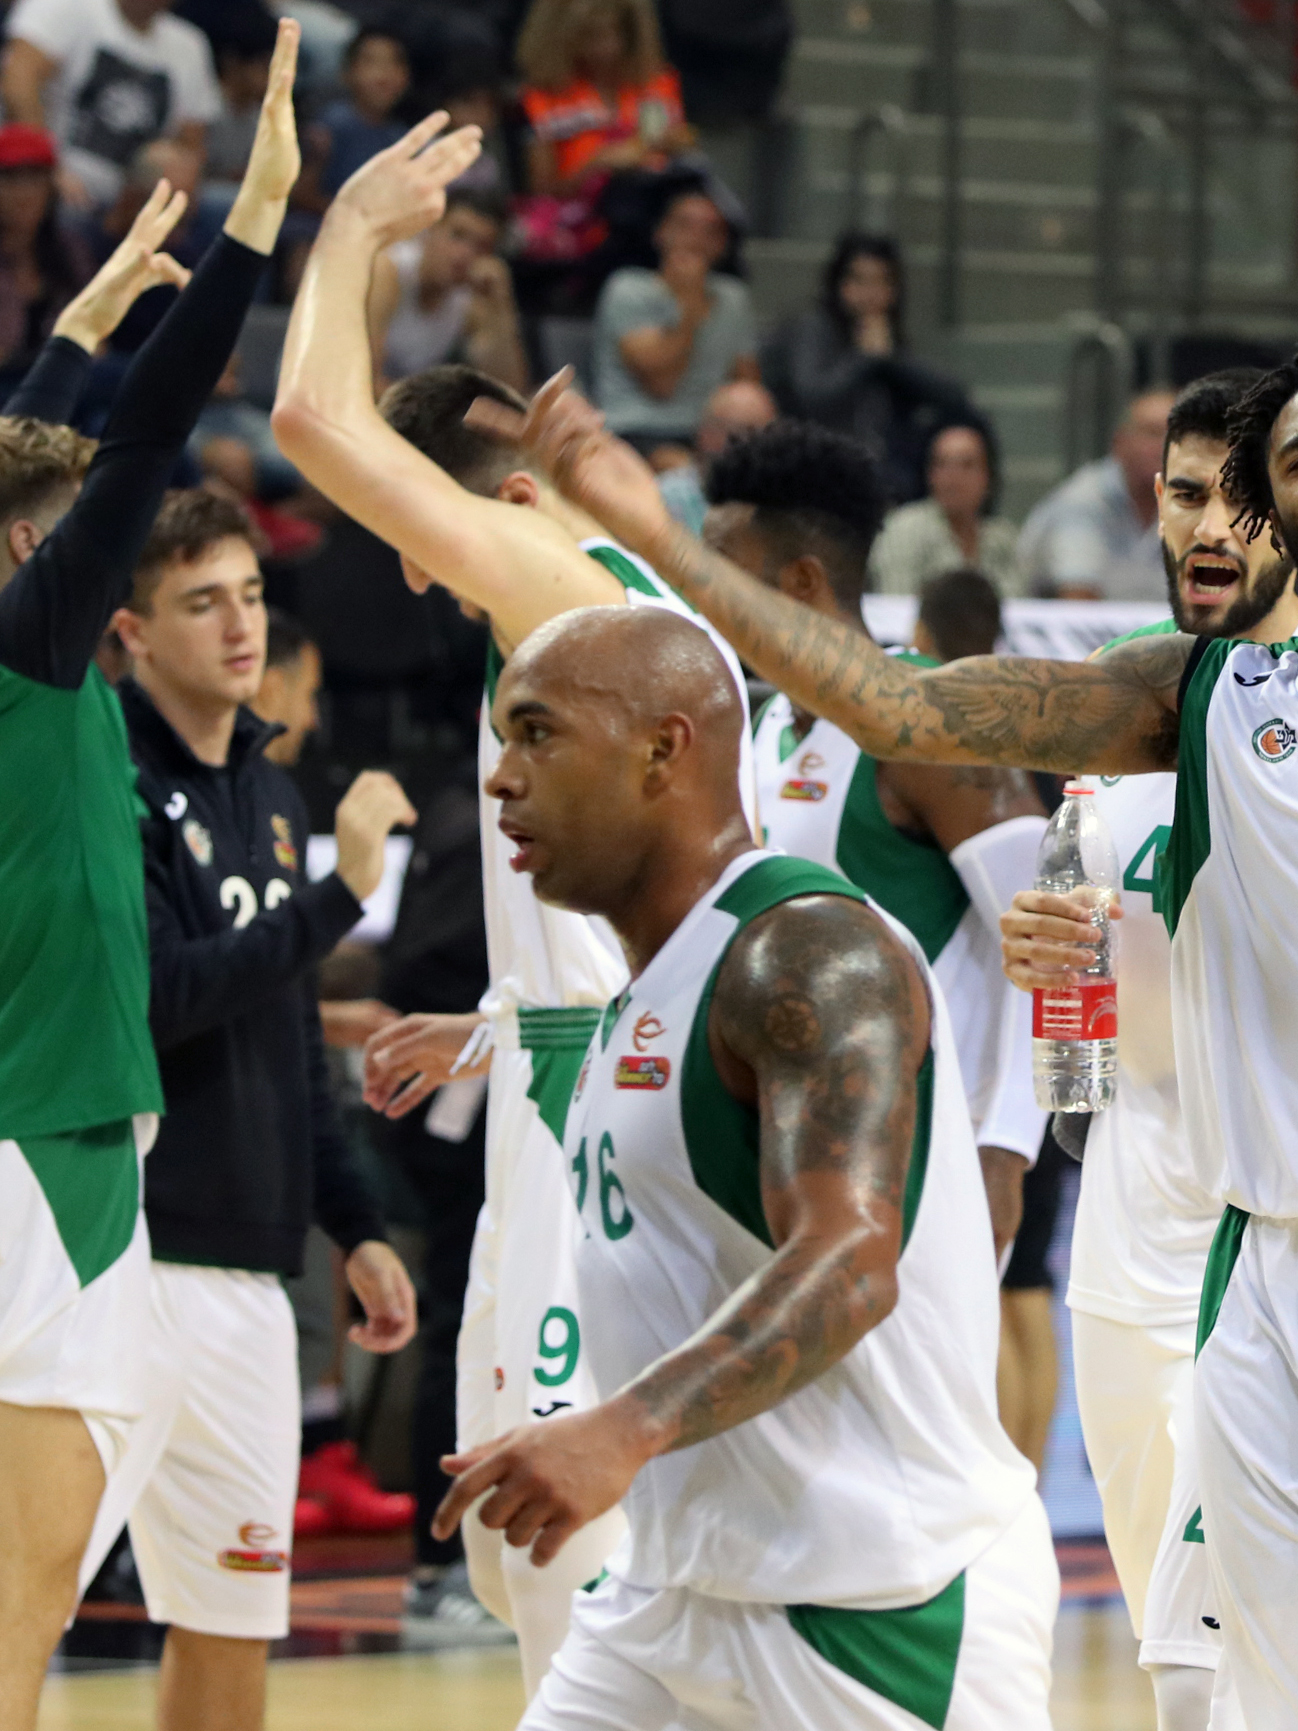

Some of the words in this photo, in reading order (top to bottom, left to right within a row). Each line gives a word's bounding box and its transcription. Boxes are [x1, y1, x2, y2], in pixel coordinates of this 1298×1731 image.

[1122, 824, 1173, 913] 4
[571, 1130, 635, 1241] 16
[533, 1305, 580, 1387] 9
